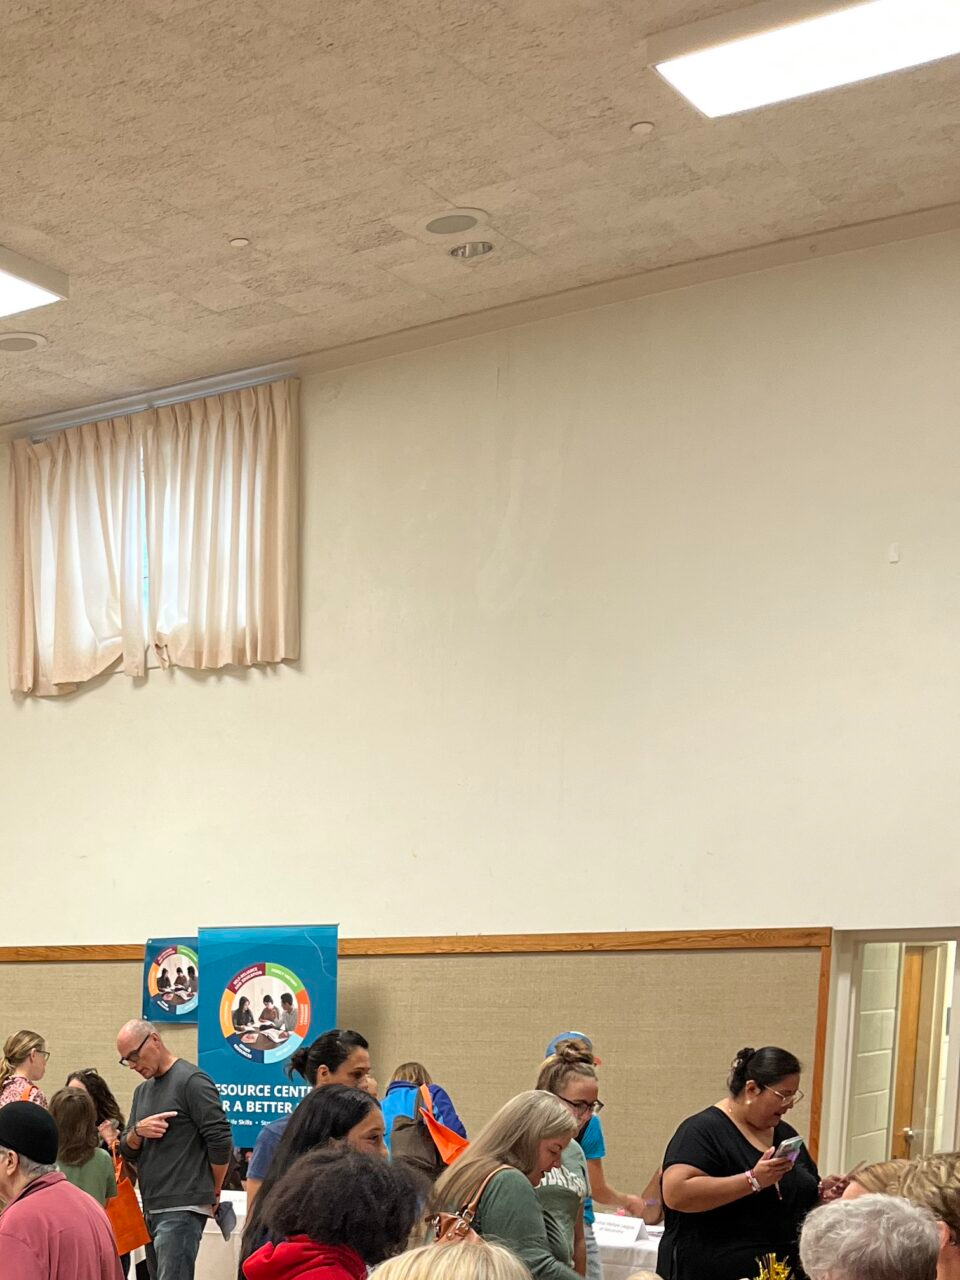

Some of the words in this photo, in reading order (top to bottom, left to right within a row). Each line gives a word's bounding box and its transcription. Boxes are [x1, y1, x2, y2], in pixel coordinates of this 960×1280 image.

[215, 1083, 271, 1097] ESOURCE
[273, 1085, 313, 1098] CENTE
[233, 1100, 243, 1112] A
[246, 1101, 293, 1114] BETTER
